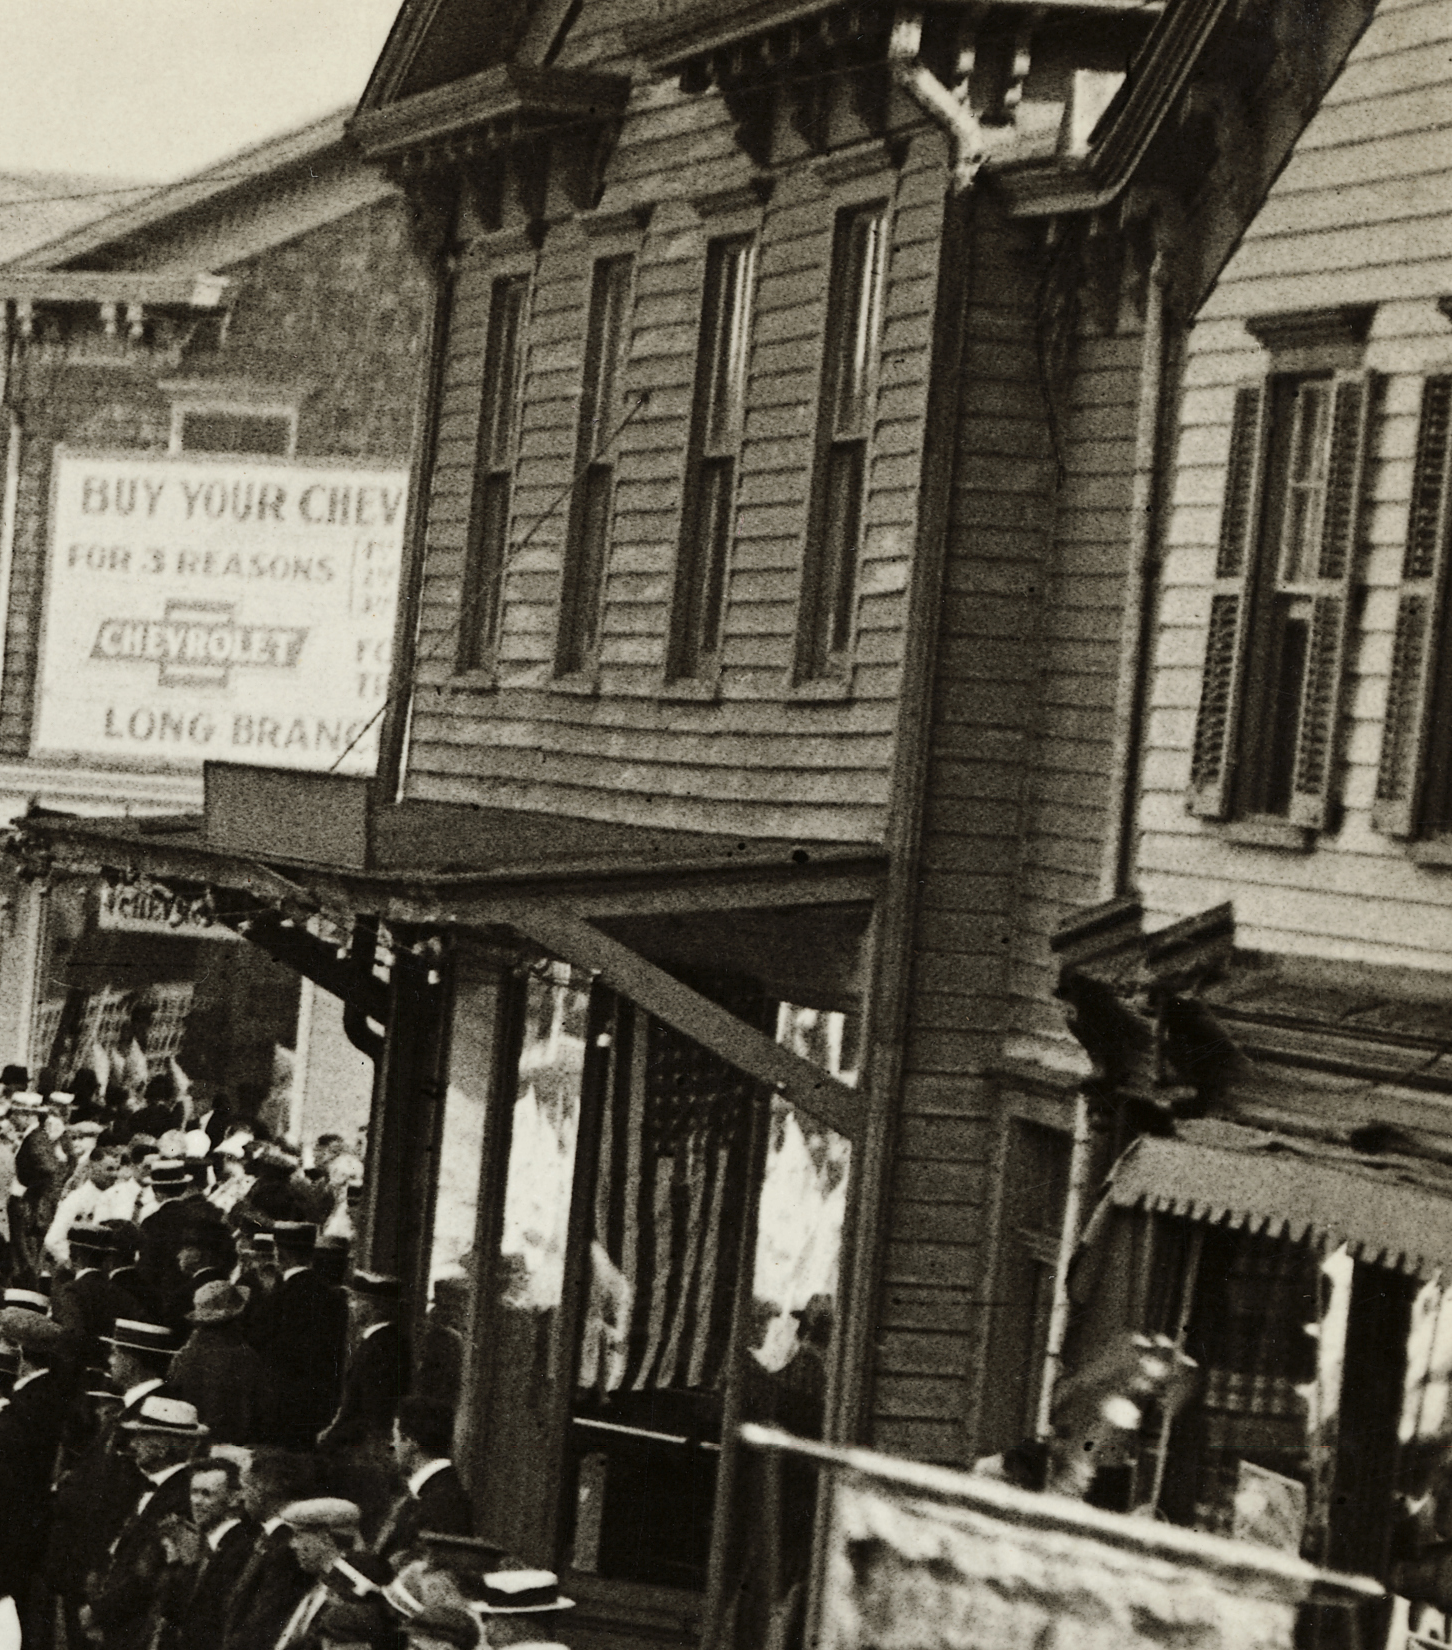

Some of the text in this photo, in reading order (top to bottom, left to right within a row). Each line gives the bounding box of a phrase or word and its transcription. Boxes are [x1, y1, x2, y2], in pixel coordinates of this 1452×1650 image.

[80, 475, 166, 518] BUY
[180, 479, 289, 523] YOUR
[67, 543, 335, 583] FOR 3 REASONS
[99, 625, 298, 665] CHEVROLET
[104, 705, 216, 745] LONG
